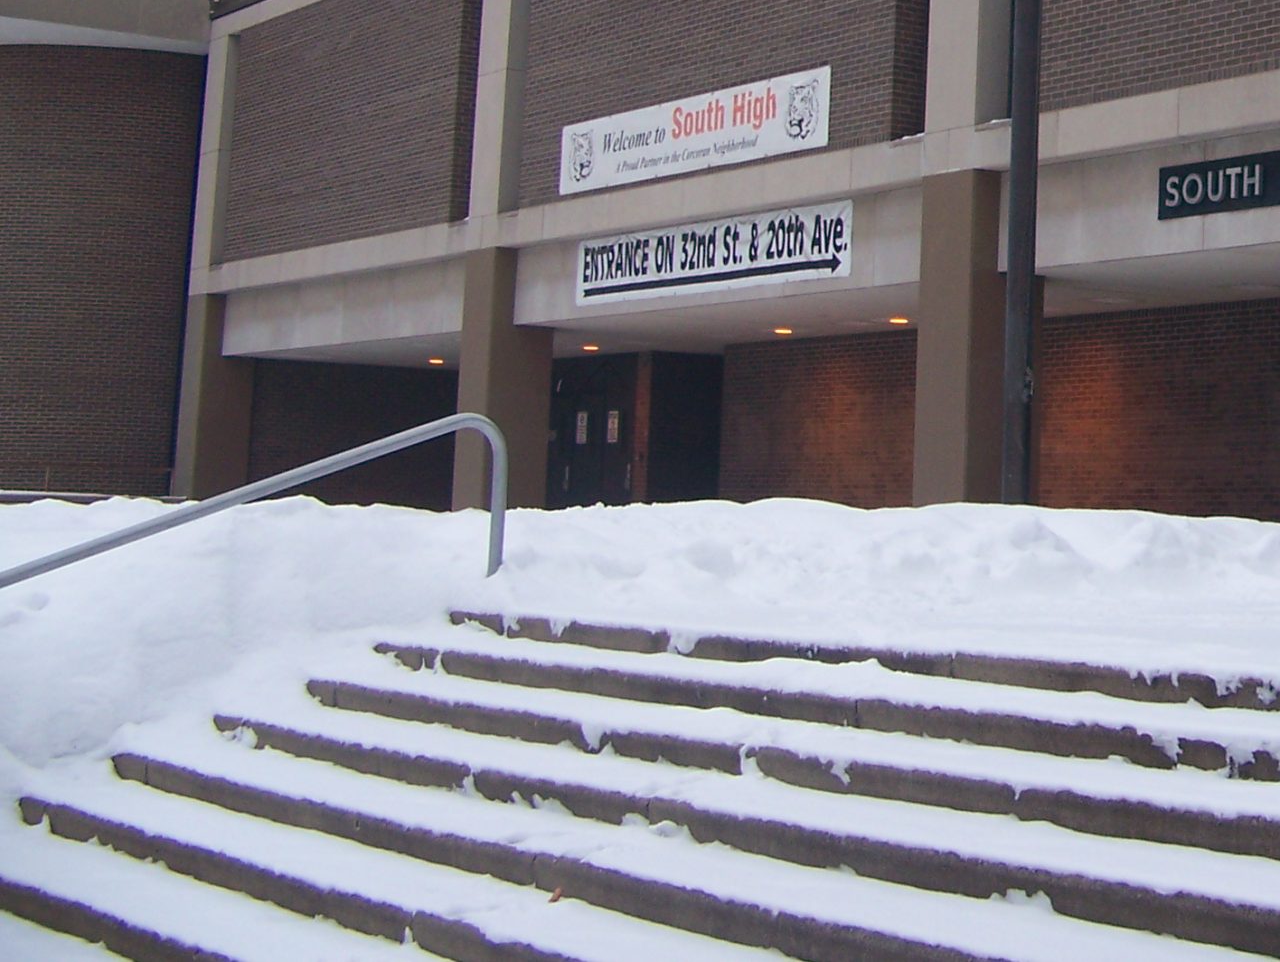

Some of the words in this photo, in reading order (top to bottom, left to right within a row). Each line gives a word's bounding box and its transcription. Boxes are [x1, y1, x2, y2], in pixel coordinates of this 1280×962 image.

[602, 129, 650, 154] Welcome
[654, 126, 667, 144] to
[672, 99, 726, 139] South
[732, 87, 777, 130] High
[1165, 164, 1263, 208] SOUTH
[582, 238, 649, 283] ENTRANCE
[655, 235, 675, 273] ON
[680, 227, 717, 270] 32nd
[722, 224, 742, 265] St.
[749, 222, 759, 262] &
[766, 215, 804, 260] 20th
[811, 214, 847, 255] Ave.
